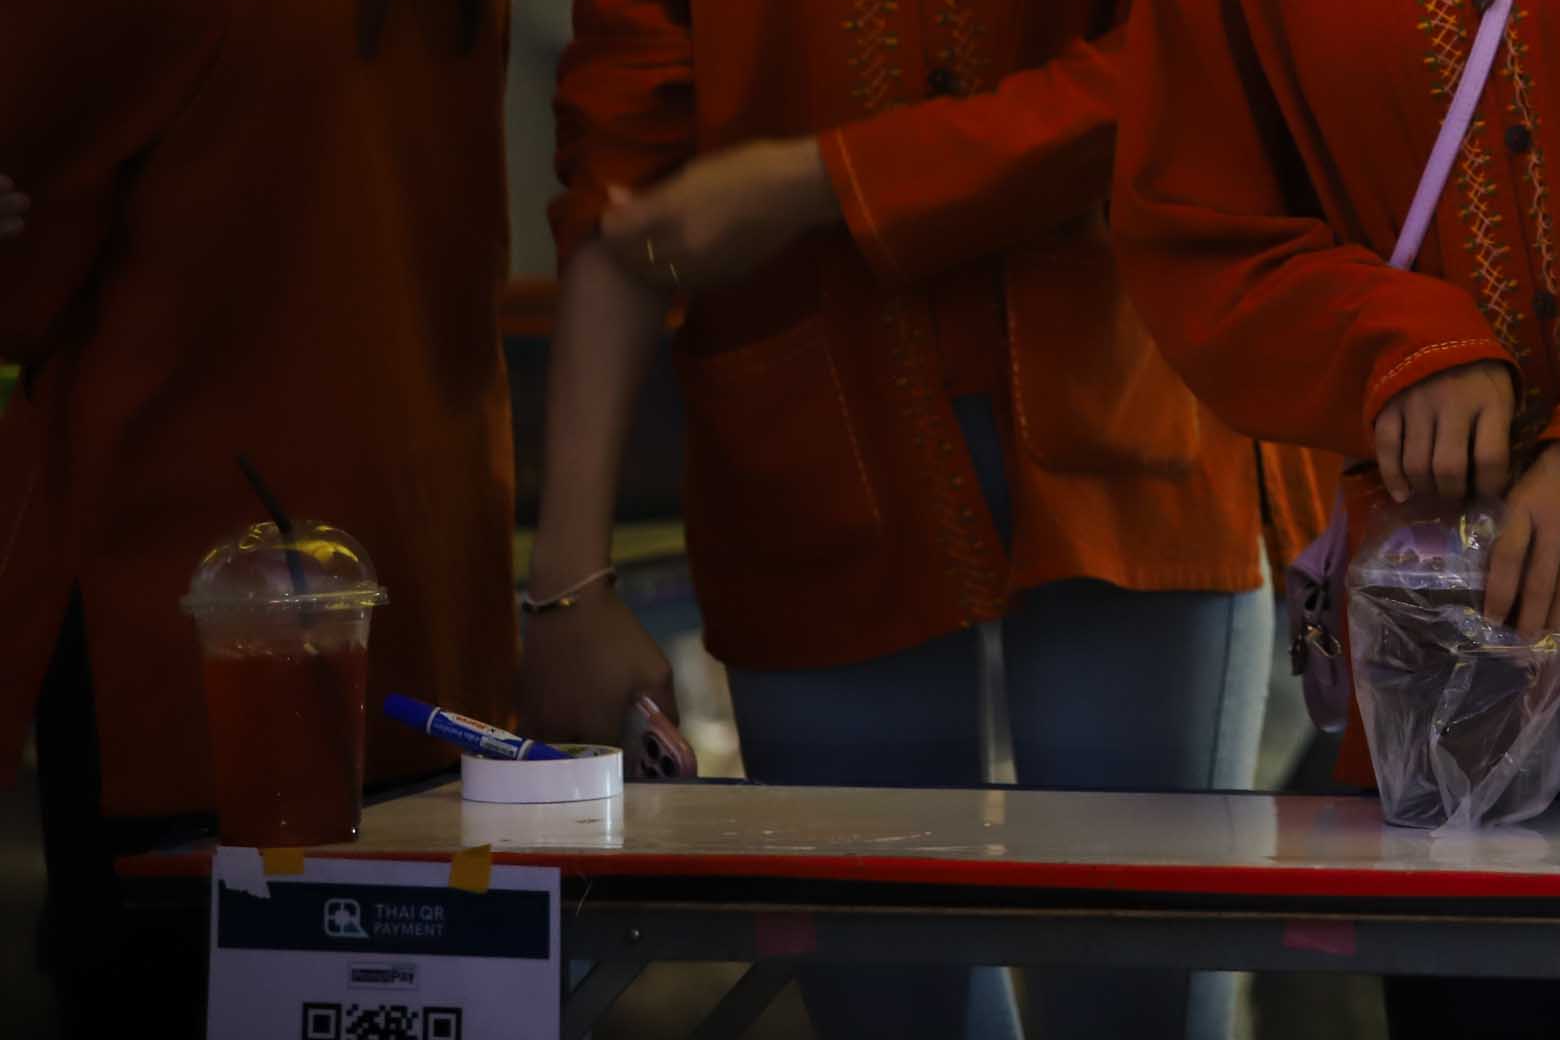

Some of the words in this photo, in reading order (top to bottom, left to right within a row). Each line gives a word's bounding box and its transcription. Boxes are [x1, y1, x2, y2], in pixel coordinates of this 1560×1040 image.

[374, 904, 416, 921] THAI
[419, 905, 445, 921] QR
[373, 921, 445, 937] PAYMENT
